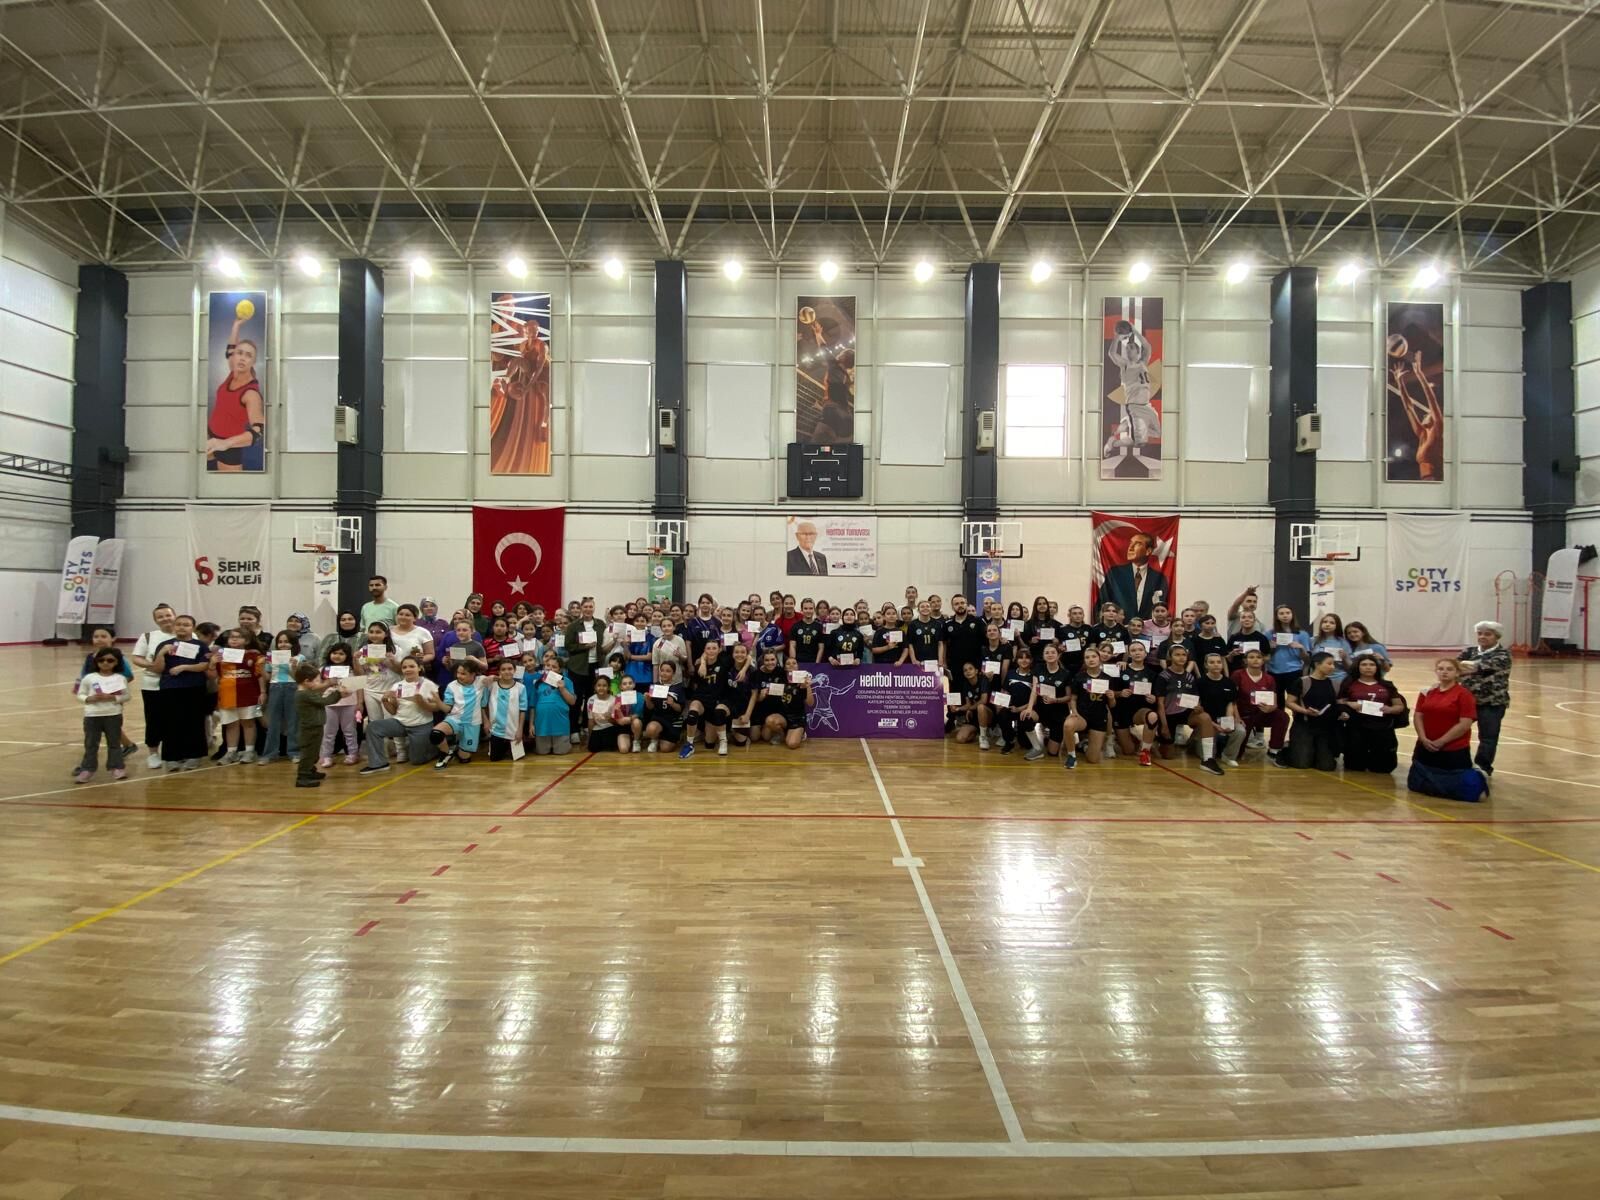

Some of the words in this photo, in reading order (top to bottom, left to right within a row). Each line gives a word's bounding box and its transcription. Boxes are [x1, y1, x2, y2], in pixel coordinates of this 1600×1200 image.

[64, 560, 78, 591] CITY
[74, 551, 93, 602] SPORTS
[1408, 568, 1448, 579] CITY
[1396, 577, 1461, 592] SPORTS
[842, 641, 852, 651] 43
[860, 672, 892, 688] Hentbol
[662, 700, 668, 709] 5
